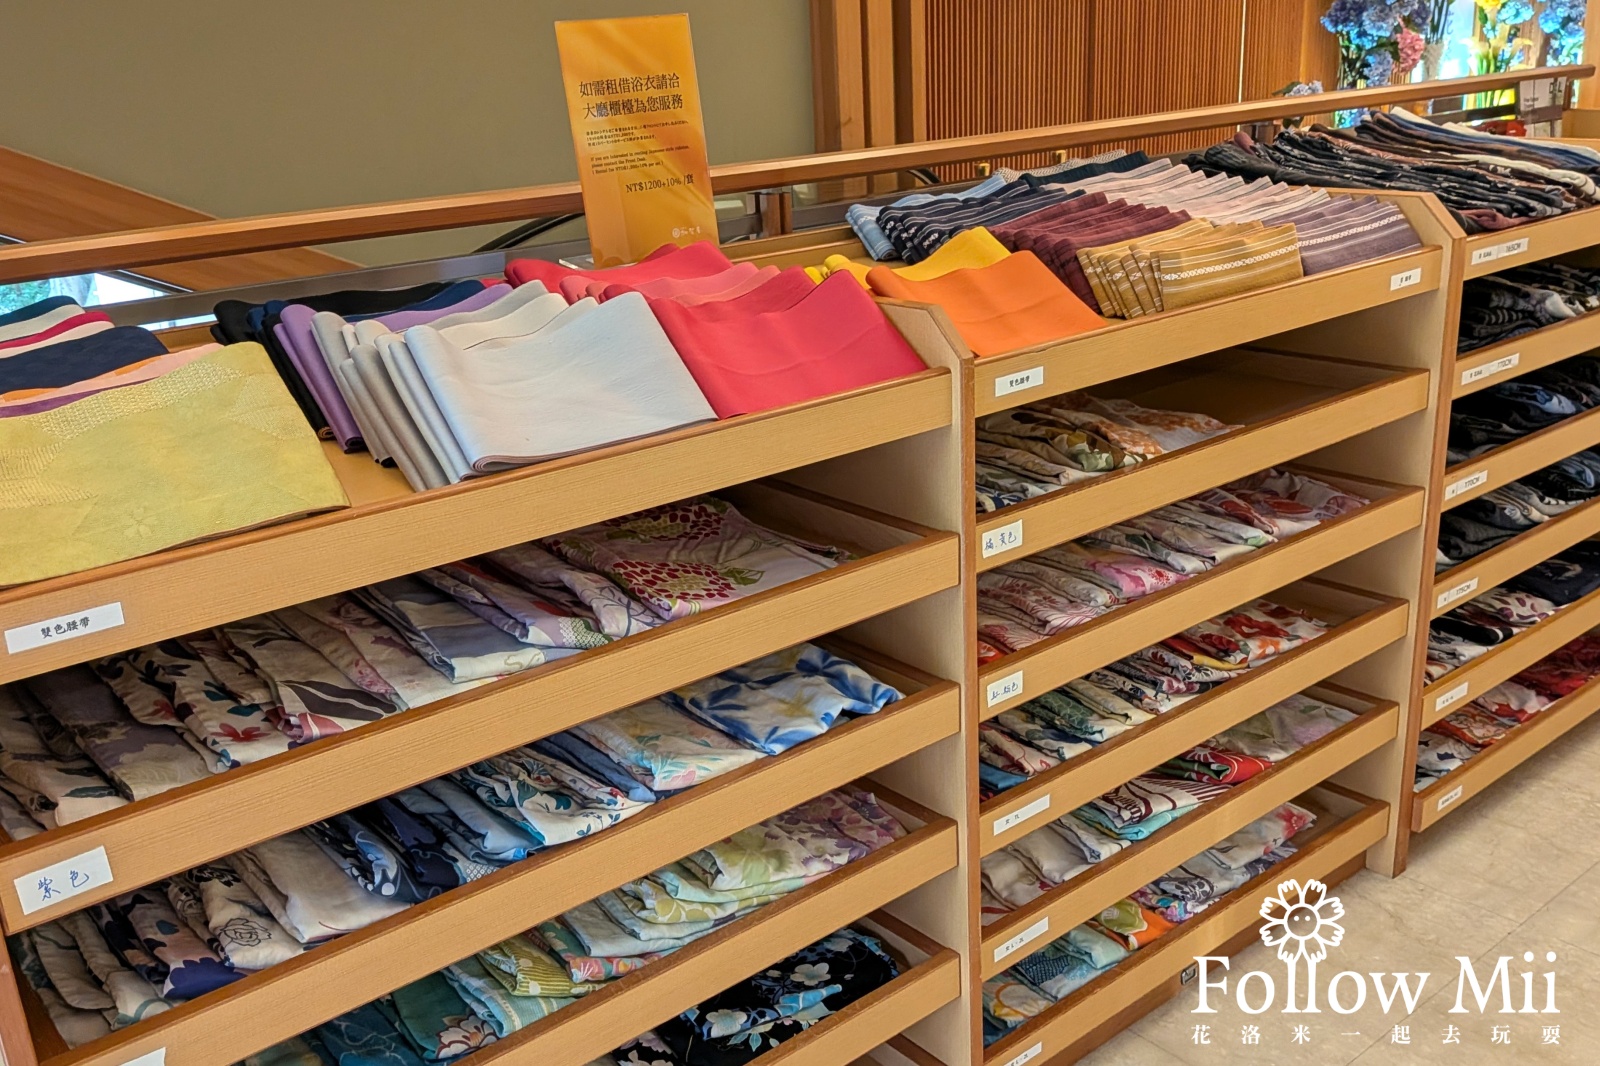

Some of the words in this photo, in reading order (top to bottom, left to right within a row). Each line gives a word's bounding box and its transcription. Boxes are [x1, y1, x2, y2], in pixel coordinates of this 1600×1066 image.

[578, 72, 680, 98] 如需租借浴衣請洽
[625, 177, 682, 193] NT$1200+10%
[40, 616, 91, 640] 雙色腰帶
[37, 869, 90, 902] 紫色
